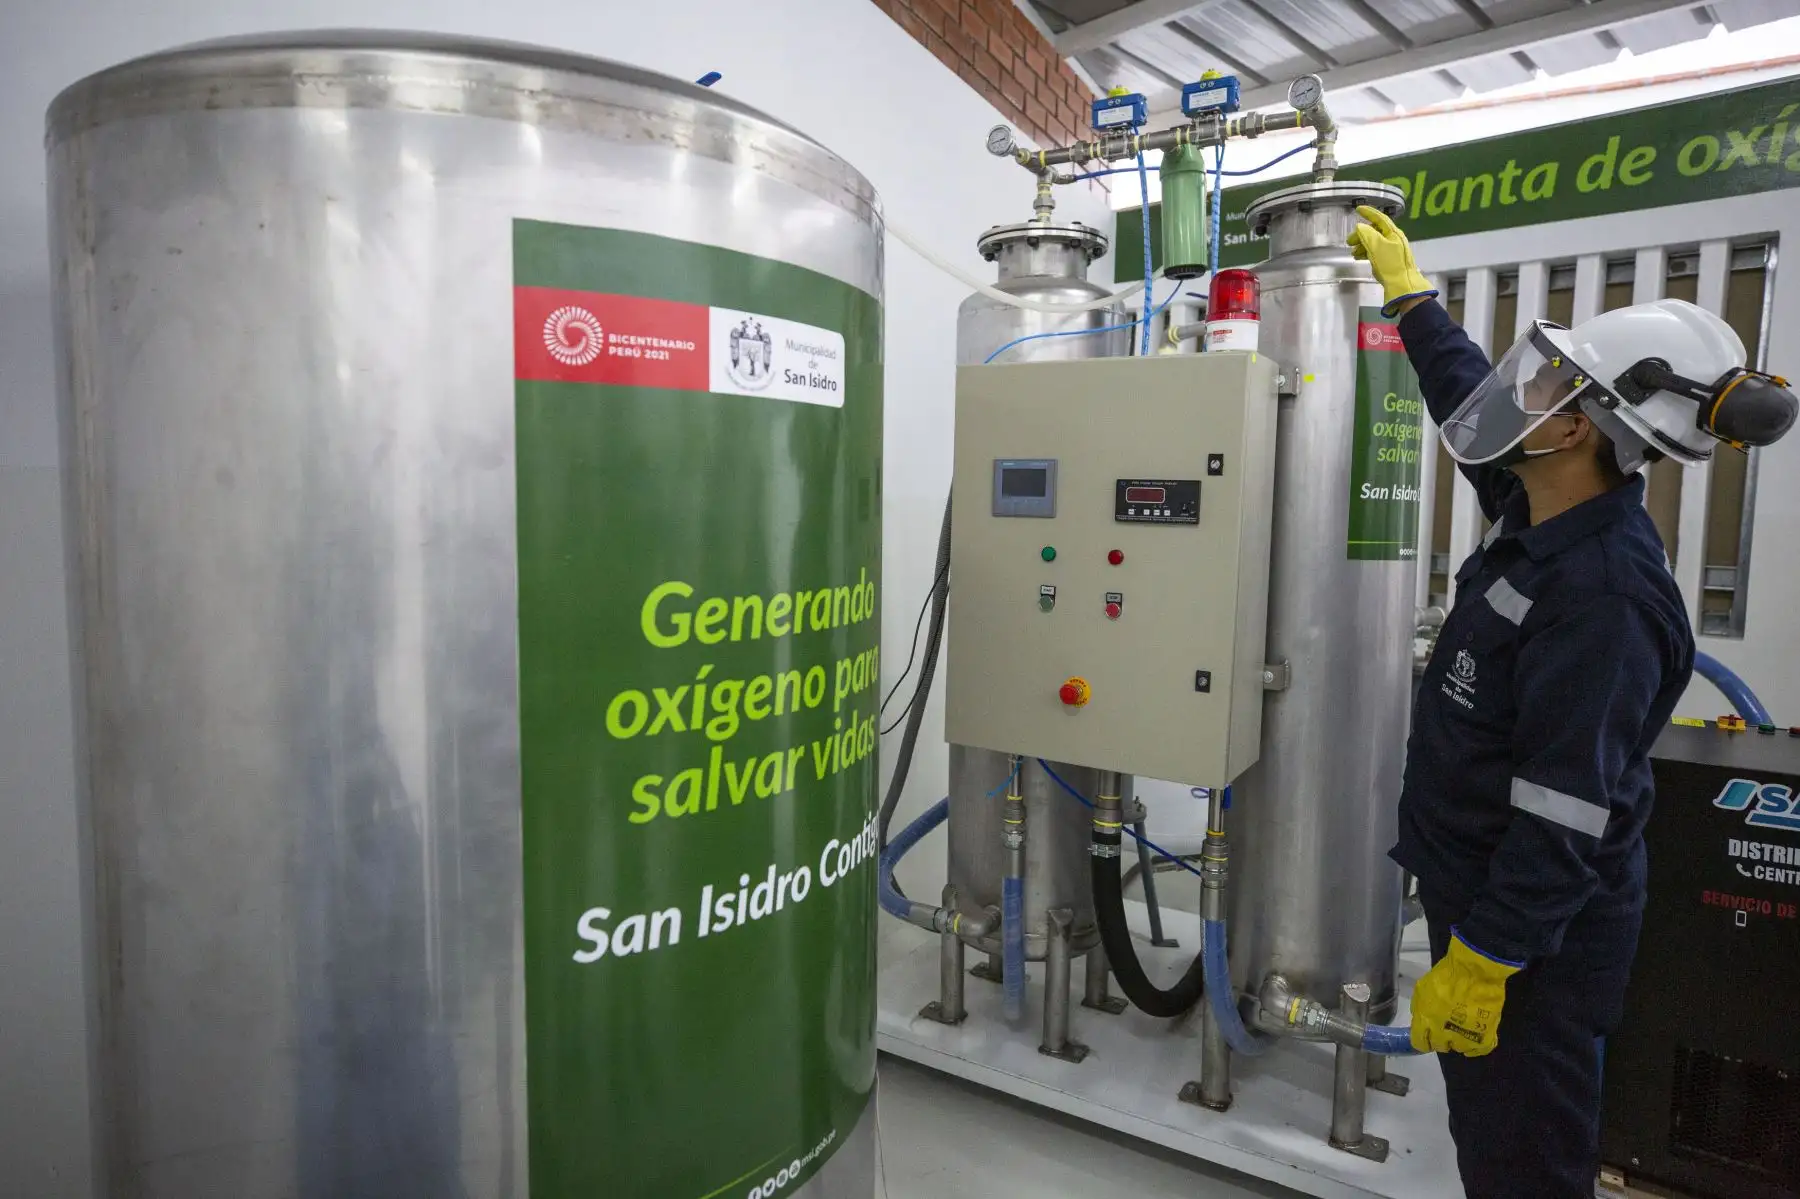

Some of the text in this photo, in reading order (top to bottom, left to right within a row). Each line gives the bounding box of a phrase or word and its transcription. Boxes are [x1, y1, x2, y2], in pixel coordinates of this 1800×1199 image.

[1576, 135, 1657, 193] de
[1224, 232, 1247, 246] San
[608, 333, 696, 351] BICENTENARIO
[644, 348, 669, 360] 2021
[785, 338, 836, 360] Municipalidad
[808, 360, 819, 370] de
[784, 368, 806, 386] San
[809, 372, 837, 392] Isidro
[1360, 482, 1388, 499] San
[1392, 484, 1417, 501] Isidro
[641, 567, 874, 648] Generando
[606, 644, 879, 741] oxígeno para
[1441, 683, 1474, 709] San Isidro
[628, 710, 875, 823] salvar vidas
[572, 907, 682, 963] San
[698, 864, 811, 937] Isidro
[1702, 889, 1797, 919] SERVICIO DE
